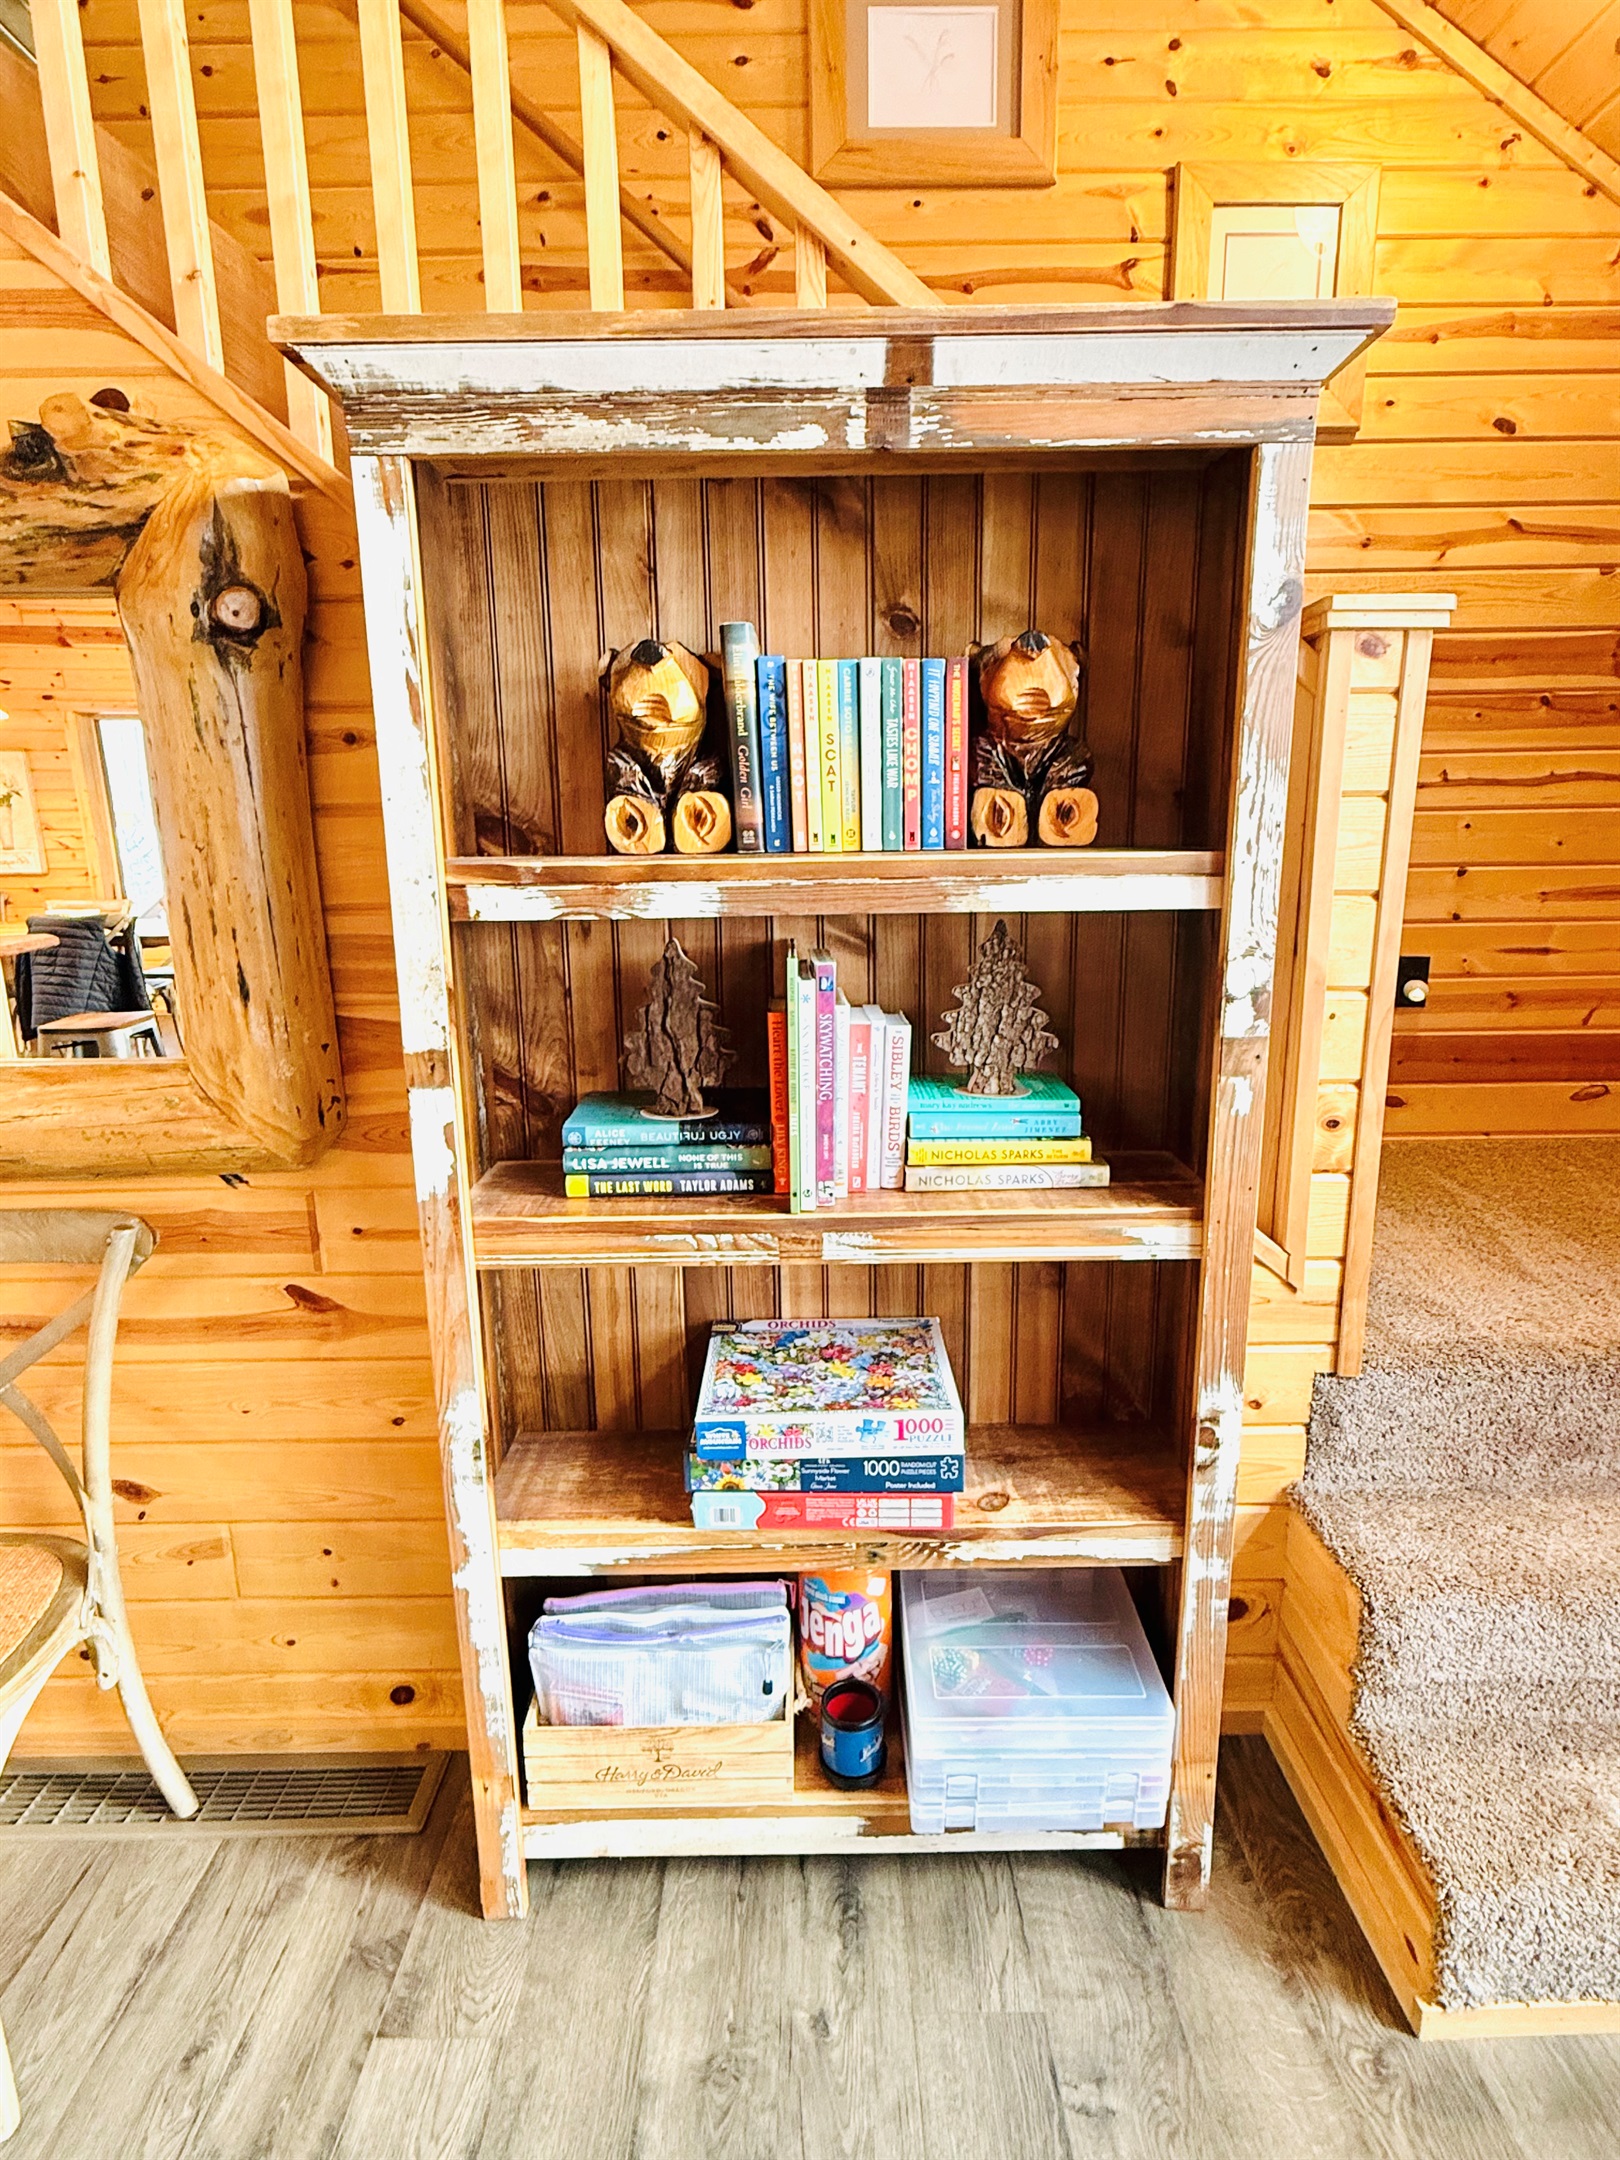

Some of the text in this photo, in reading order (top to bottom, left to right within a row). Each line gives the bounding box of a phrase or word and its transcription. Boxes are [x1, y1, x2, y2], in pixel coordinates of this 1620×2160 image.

[928, 668, 940, 678] IT
[953, 664, 961, 678] THE
[732, 644, 748, 736] Elin Hilderbrand
[767, 674, 775, 691] THE
[843, 667, 852, 703] CARRIE
[844, 706, 852, 733] SOTO
[770, 717, 778, 758] BETWEEN
[952, 727, 961, 752] SECRET
[825, 733, 837, 792] SCAT
[886, 718, 899, 789] TASTES LIKE WAR
[771, 760, 778, 771] US
[793, 742, 803, 803] HOOT
[906, 727, 918, 802] CHOMP
[738, 745, 753, 809] Golden Girl
[772, 1020, 786, 1112] Heart the Lover
[819, 1013, 833, 1101] SKYWATCHING
[890, 1035, 904, 1091] SIBLEY
[852, 1055, 867, 1095] TENANT
[595, 1129, 626, 1138] ALICE
[709, 1130, 741, 1141] UGLY
[888, 1106, 901, 1151] BIRDS
[589, 1138, 631, 1146] FEENEY
[776, 1124, 789, 1173] LILY KING
[572, 1157, 671, 1170] LISA JEWELL
[678, 1154, 706, 1163] NONE
[721, 1153, 744, 1161] THIS
[931, 1149, 1044, 1161] NICHOLAS SPARKS
[693, 1162, 702, 1170] IS
[594, 1180, 673, 1193] THE LAST WORD
[680, 1179, 754, 1192] TAYLOR ADAMS
[918, 1173, 1045, 1187] NICHOLAS SPARKS
[767, 1319, 836, 1330] ORCHIDS
[893, 1417, 943, 1442] 1000
[909, 1434, 952, 1443] PUZZLE
[748, 1436, 812, 1450] ORCHIDS
[863, 1459, 900, 1477] 1000
[908, 1481, 936, 1489] Included
[801, 1596, 881, 1659] Jenga
[595, 1761, 723, 1786] Harry & David
